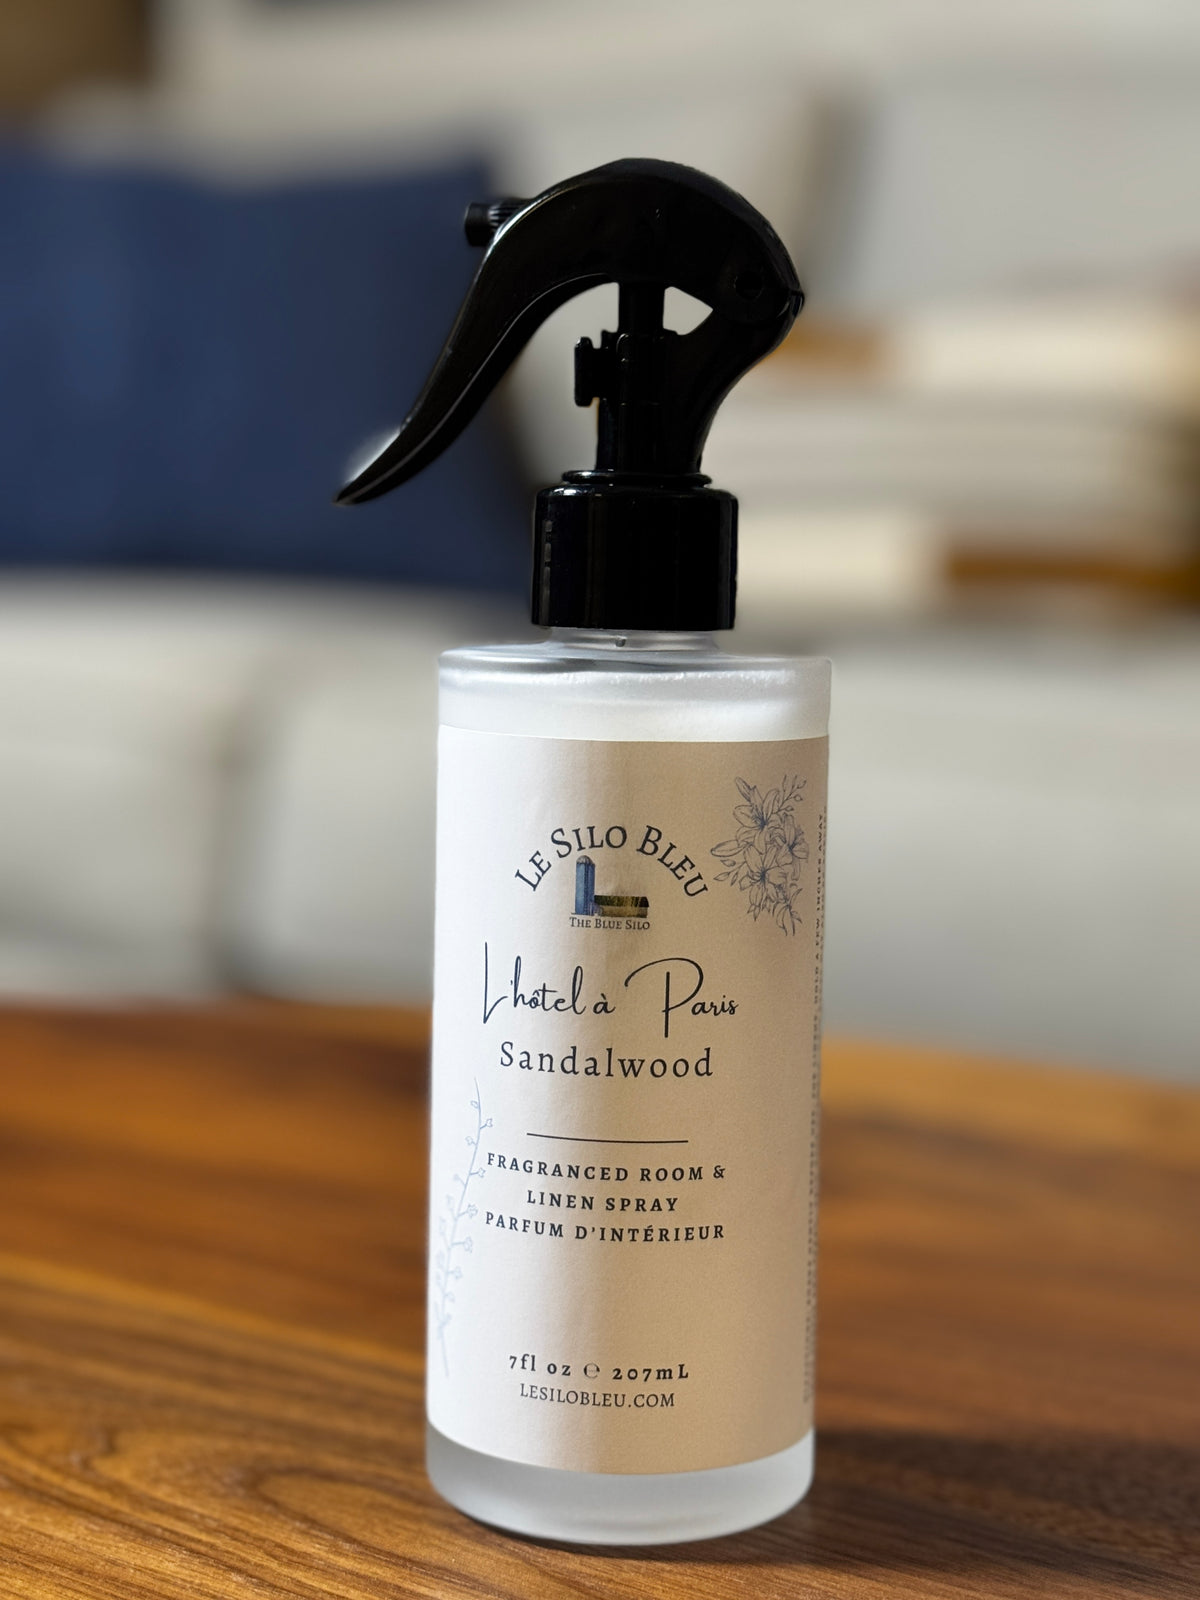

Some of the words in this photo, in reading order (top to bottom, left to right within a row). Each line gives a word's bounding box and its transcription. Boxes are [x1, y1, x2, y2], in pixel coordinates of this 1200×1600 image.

[514, 851, 552, 891] LE
[550, 825, 628, 859] SILO
[635, 824, 709, 898] BLEU
[568, 916, 593, 929] THE
[594, 917, 624, 930] BLUE
[625, 918, 651, 931] SILO
[482, 941, 587, 1025] L'hôtel
[591, 992, 616, 1015] à
[623, 957, 739, 1039] Paris
[499, 1041, 714, 1079] Sandalwood
[486, 1152, 629, 1182] FRAGRANCED
[639, 1166, 704, 1183] ROOM
[712, 1164, 727, 1180] &
[526, 1189, 595, 1211] LINEN
[605, 1197, 679, 1213] SPRAY
[485, 1210, 564, 1238] PARFUM
[574, 1224, 725, 1243] D'INTÉRIEUR
[508, 1353, 537, 1373] 7fl
[546, 1362, 572, 1377] oz
[612, 1363, 689, 1383] 207mL
[519, 1383, 675, 1409] LESILOBLEU.COM
